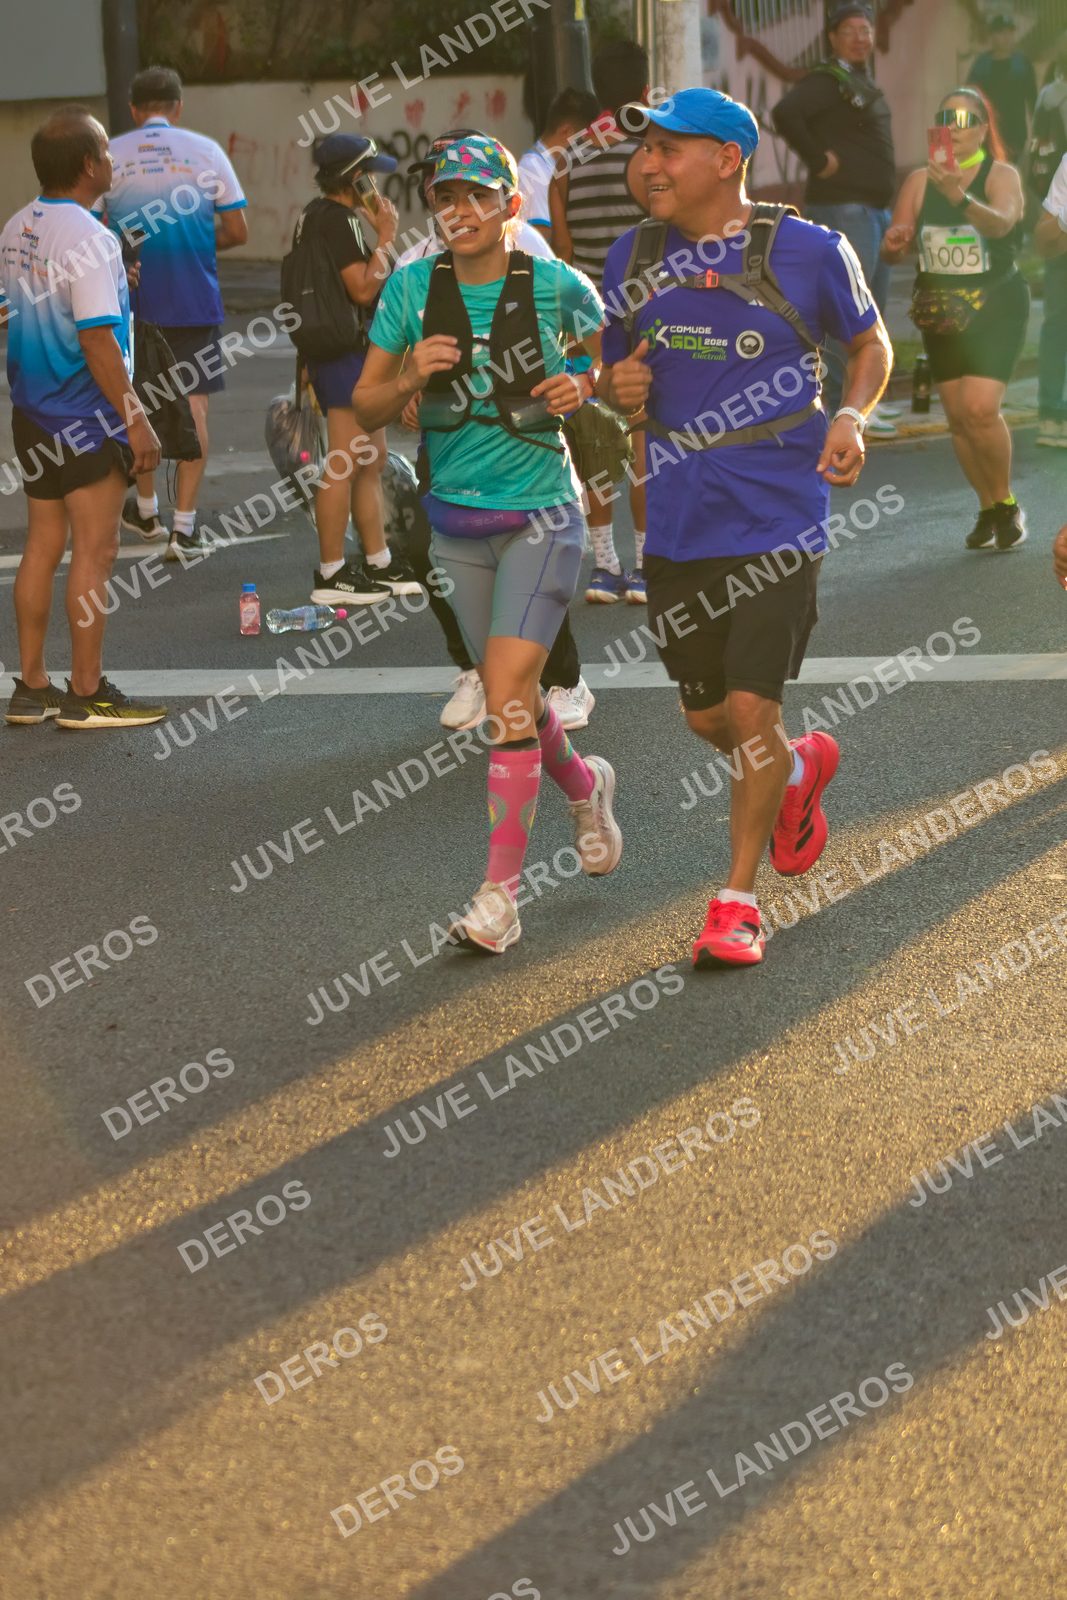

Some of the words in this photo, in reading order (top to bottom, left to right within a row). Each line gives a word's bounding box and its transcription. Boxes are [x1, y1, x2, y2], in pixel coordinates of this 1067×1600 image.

[926, 245, 980, 268] 1005
[669, 325, 713, 335] COMUDE
[671, 335, 709, 350] GDL
[335, 582, 355, 593] HOKA
